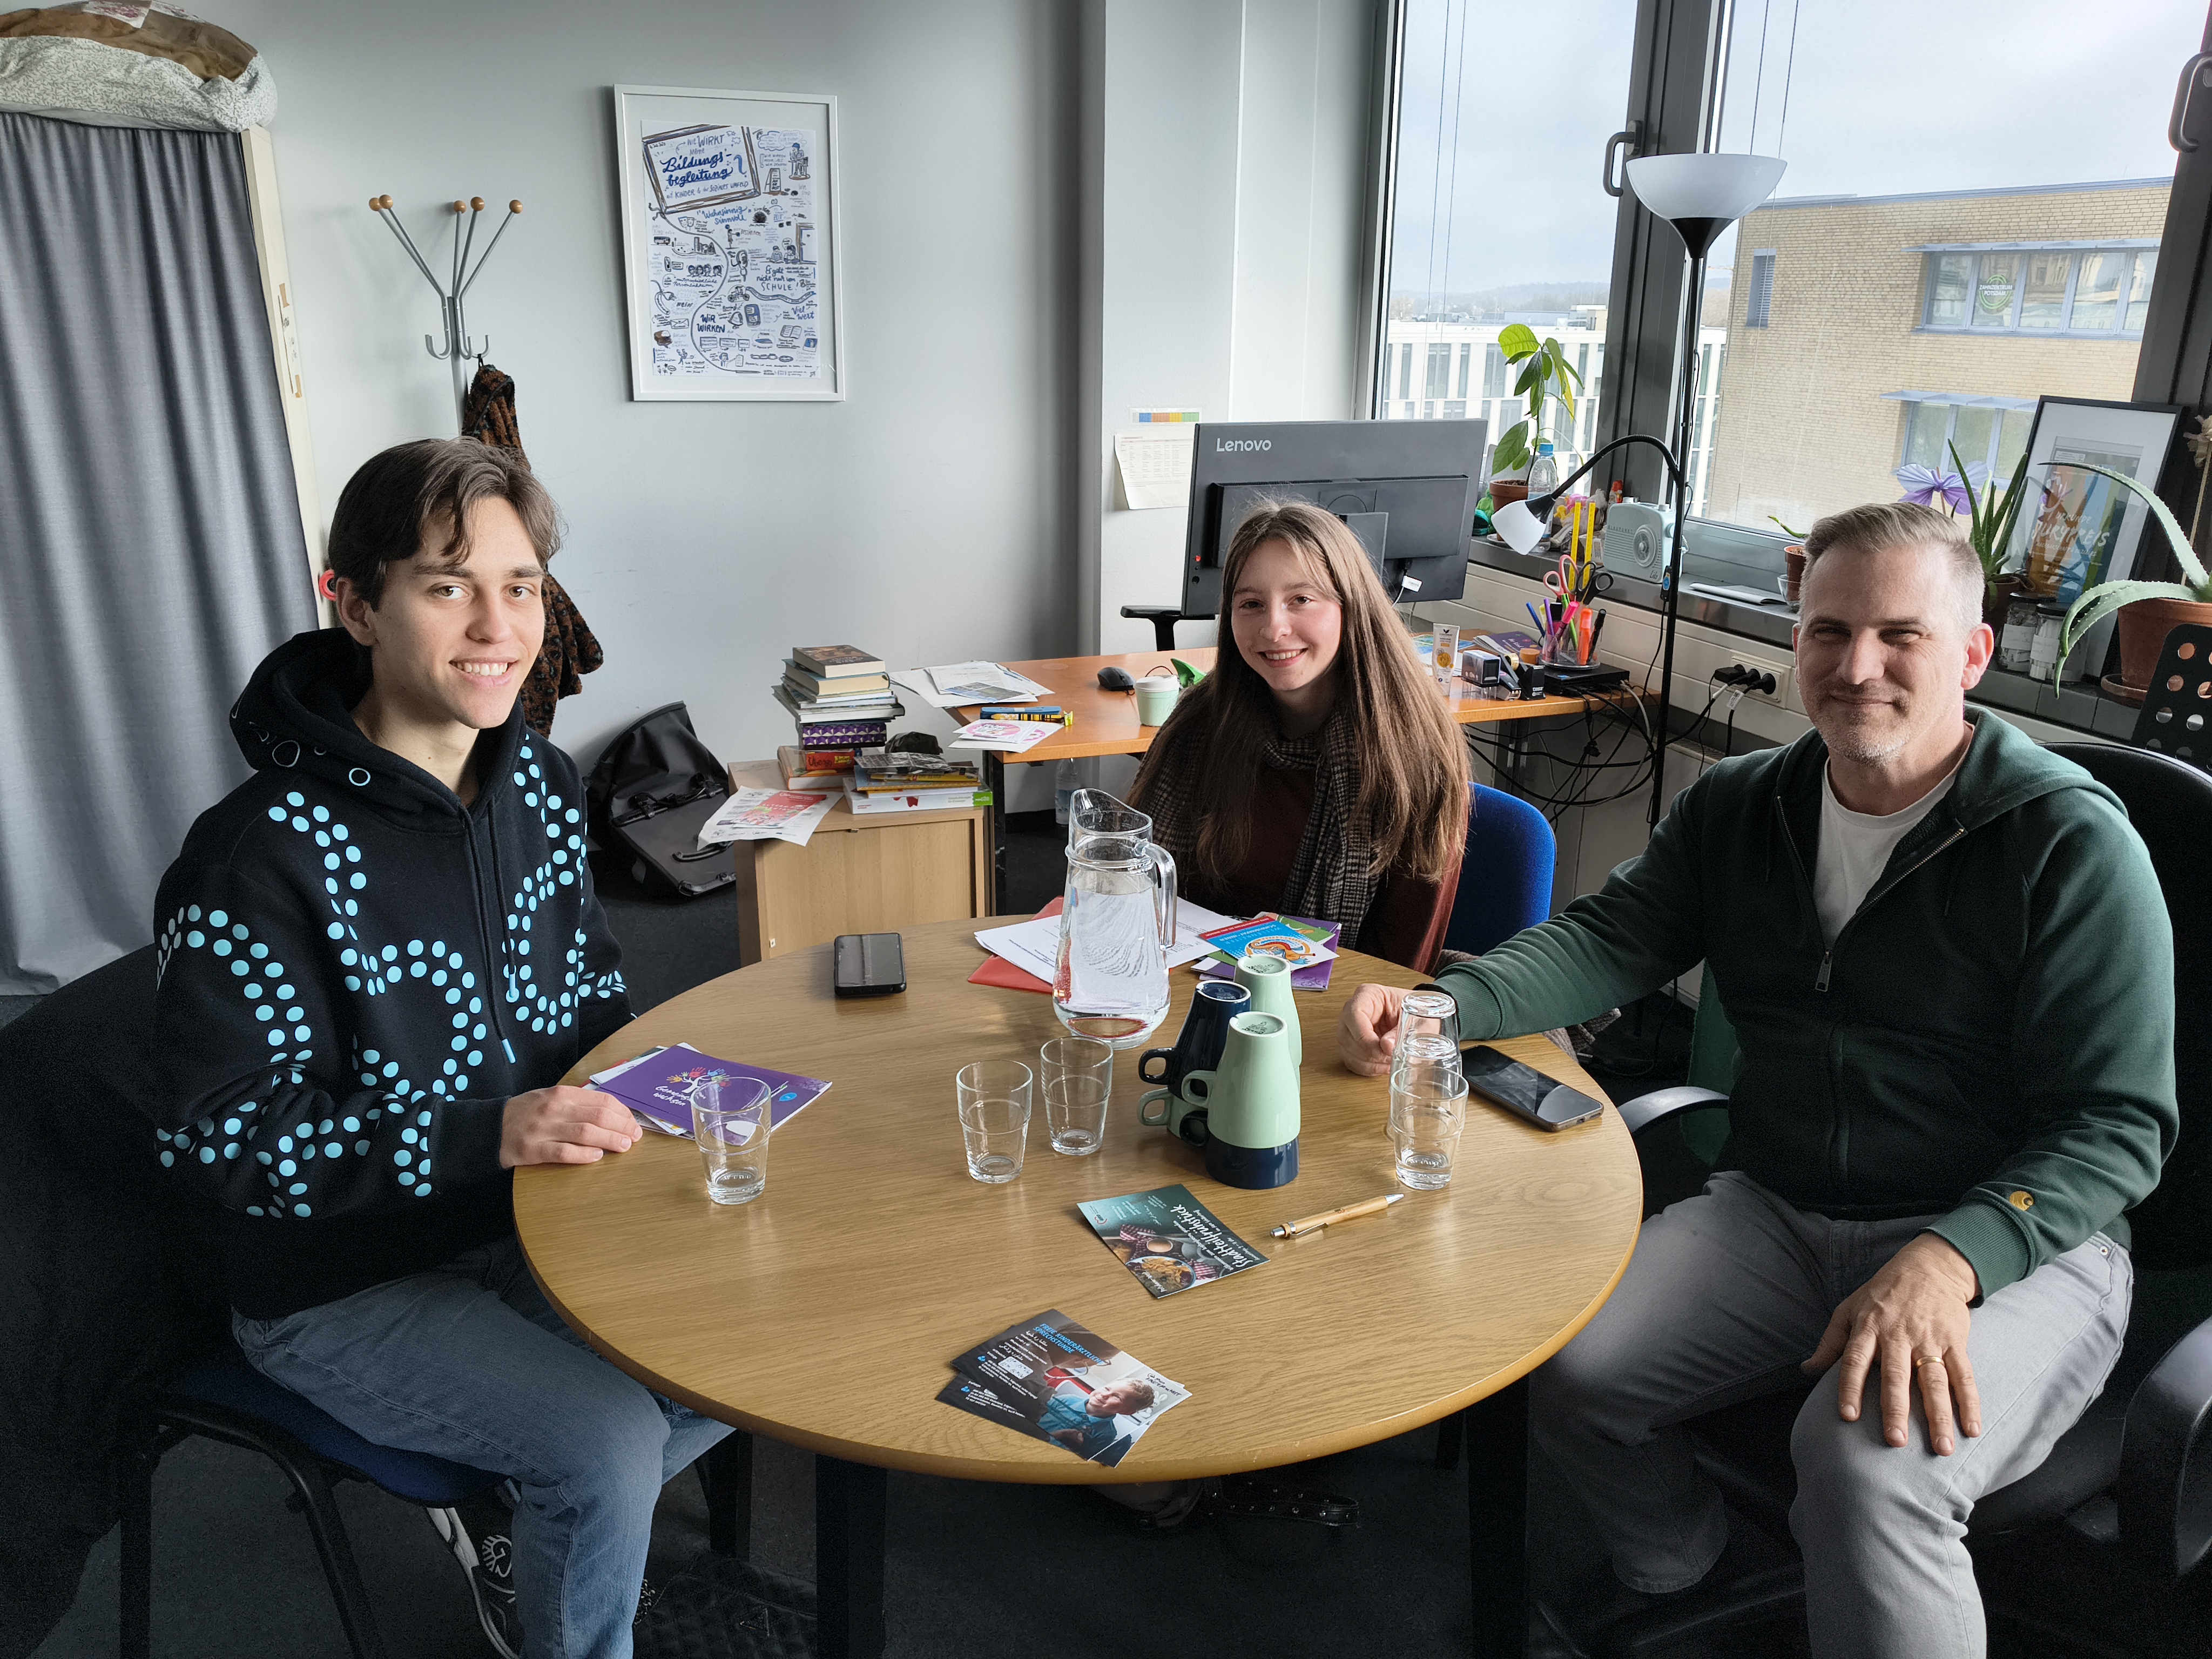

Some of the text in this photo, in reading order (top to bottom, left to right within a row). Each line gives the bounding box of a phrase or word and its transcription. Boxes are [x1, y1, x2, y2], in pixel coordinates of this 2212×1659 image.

[660, 151, 732, 173] Bildungs-
[665, 167, 733, 187] begleitung
[1216, 438, 1272, 451] Lenovo
[1608, 525, 1632, 533] BLAUPUNKT
[1170, 1204, 1253, 1267] Stadtteilfrühstück
[1033, 1326, 1075, 1354] SPRECHSTUNDE
[1040, 1323, 1105, 1365] FREIE KINDERÄRZTLICHE
